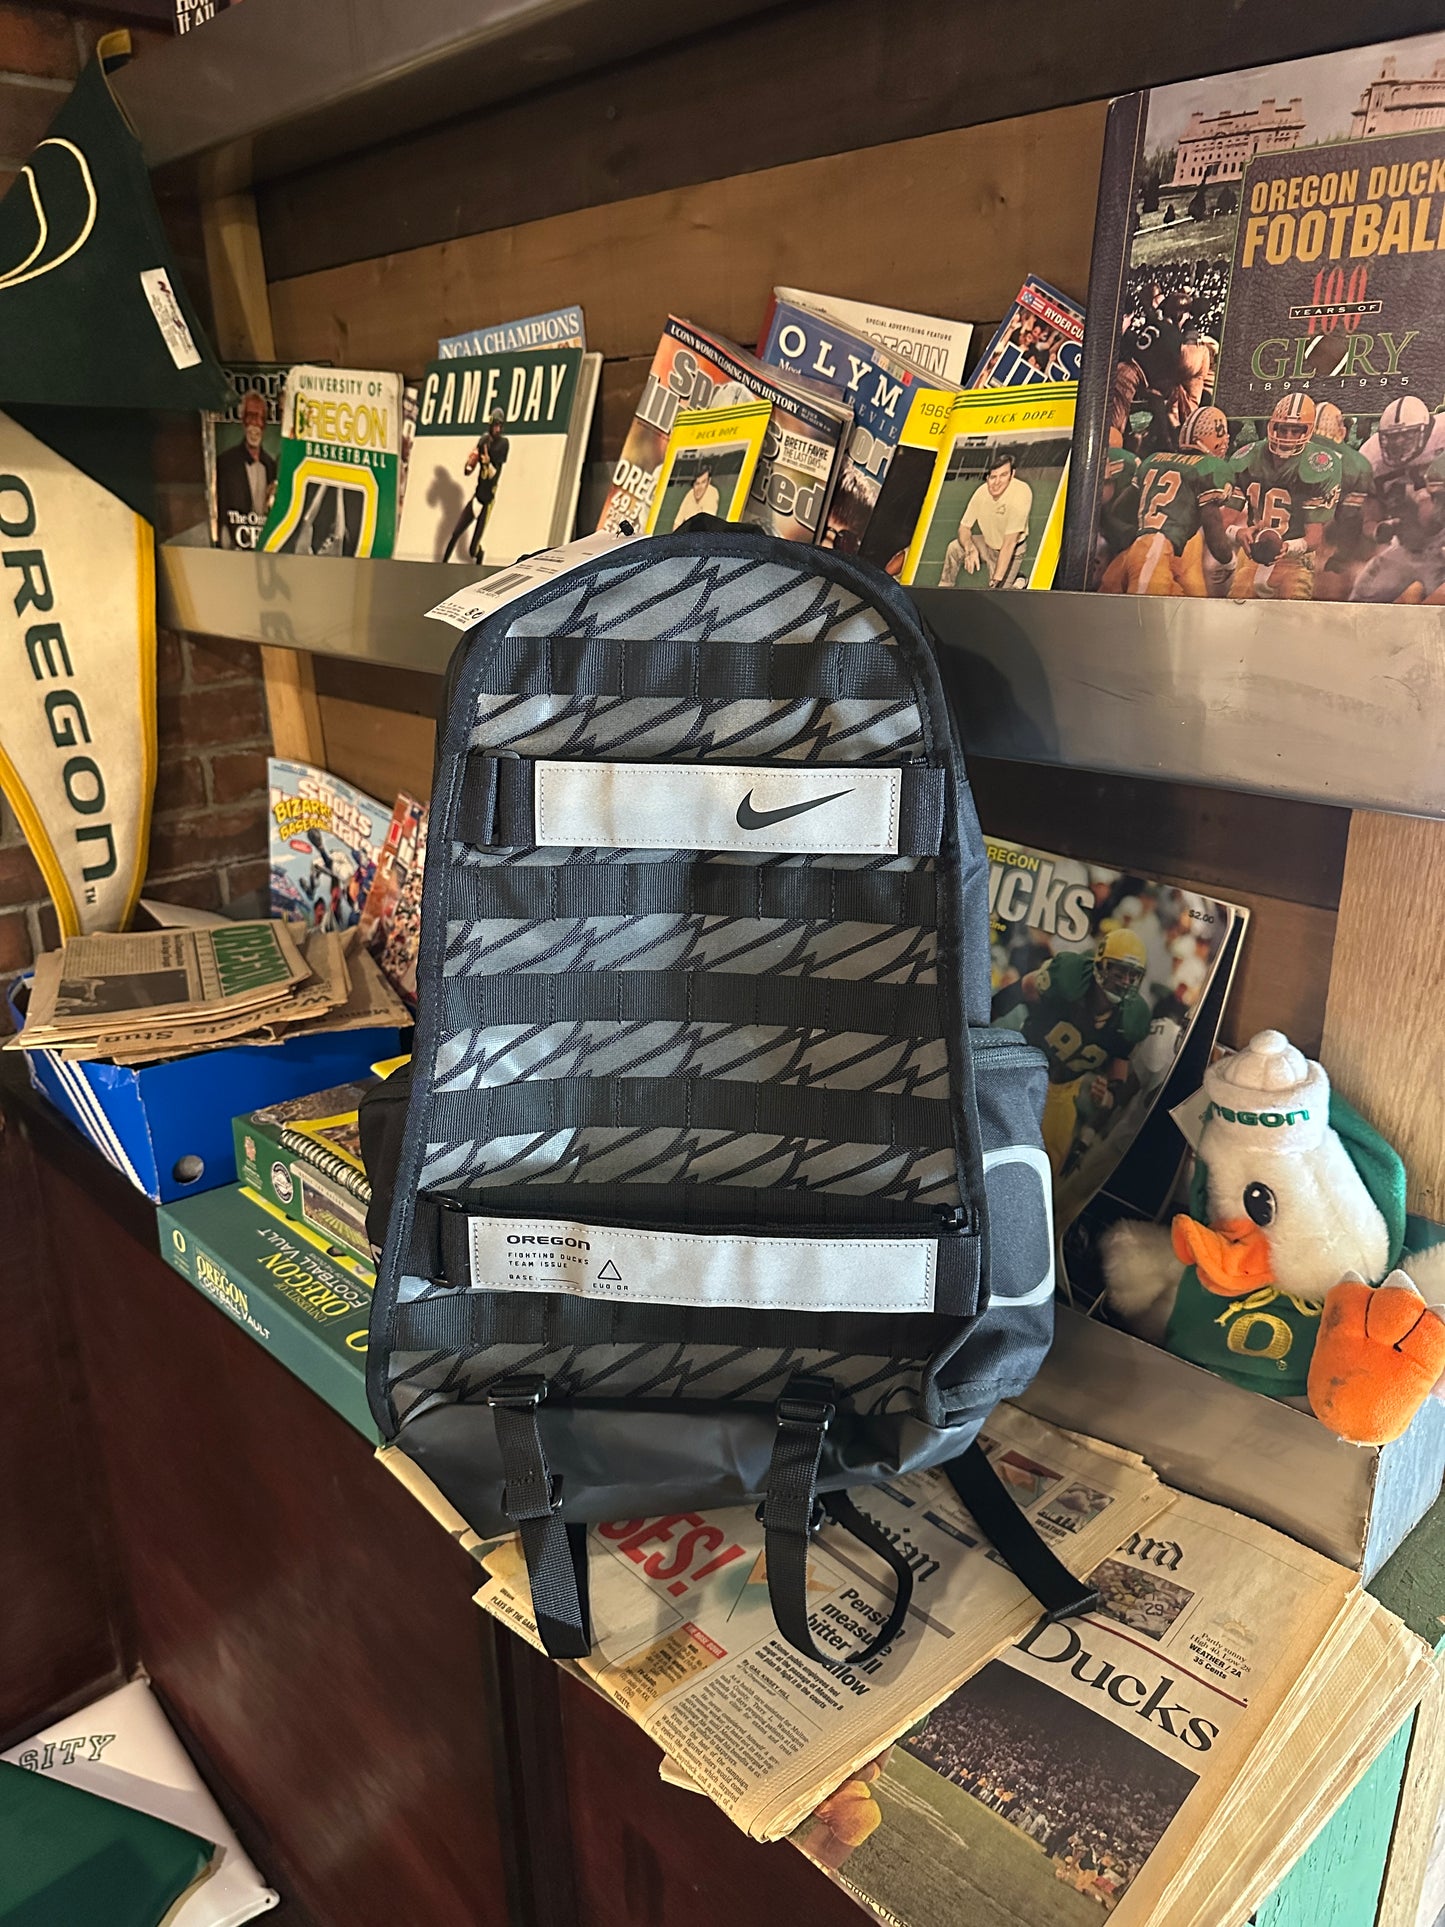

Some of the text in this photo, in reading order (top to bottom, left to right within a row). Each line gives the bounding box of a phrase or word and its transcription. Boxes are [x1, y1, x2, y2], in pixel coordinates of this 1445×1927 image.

[1250, 170, 1358, 214] OREGON
[1294, 303, 1378, 317] YEARS OF
[1308, 264, 1368, 335] 100
[440, 312, 580, 359] NCAA CHAMPIONS
[866, 317, 952, 342] SPECIAL ADVERTISING FEATURE
[1044, 307, 1071, 332] RYDER
[300, 375, 382, 396] UNIVERSITY OF
[670, 324, 800, 414] UCONN WOMEN CLOSING IN ON HISTORY
[421, 368, 500, 426] GAME
[506, 364, 567, 423] DAY
[294, 392, 388, 450] OREGON
[696, 426, 739, 441] DUCK DOPE
[984, 410, 1056, 424] DUCK DOPE
[306, 442, 386, 468] BASKETBALL
[784, 435, 829, 462] BRETT FAVRE
[793, 450, 807, 464] LAST
[806, 454, 822, 469] DAYS
[1138, 468, 1182, 530] 12
[1246, 482, 1292, 540] 16
[0, 474, 118, 883] OREGON
[1188, 908, 1215, 924] $2.00
[212, 924, 290, 997] OREGON
[193, 994, 332, 1038] Webfoots
[103, 1029, 174, 1044] Stun
[506, 1234, 590, 1250] OREGON
[560, 1254, 590, 1265] DUCKS
[196, 1254, 248, 1312] OREGON
[256, 1227, 370, 1309] FOOTBALL VAULT
[508, 1260, 568, 1269] TEAM ISSUE
[258, 1251, 350, 1319] OREGON
[274, 1282, 328, 1324] UNIVERSITY OF
[243, 1308, 271, 1340] VAULT
[1034, 1518, 1068, 1538] WEATHER
[490, 1594, 507, 1610] PLAYS
[504, 1604, 513, 1615] OF
[512, 1609, 523, 1623] THE
[521, 1616, 536, 1633] GAME
[808, 1613, 852, 1651] bitter
[821, 1603, 892, 1656] measue
[839, 1588, 906, 1640] Pensin
[693, 1631, 710, 1644] ROSE
[705, 1641, 723, 1656] BOWL
[1189, 1642, 1226, 1668] WEATHER
[1230, 1668, 1242, 1678] 2A
[1190, 1634, 1208, 1650] High
[1222, 1653, 1240, 1666] Low
[1240, 1664, 1252, 1673] 28
[1202, 1632, 1248, 1662] Partly sunny
[748, 1663, 761, 1675] GAIL
[760, 1673, 779, 1690] KINSEY
[777, 1687, 790, 1699] HILL
[761, 1644, 777, 1658] anger
[788, 1665, 811, 1685] passage
[814, 1686, 839, 1708] Measure
[762, 1656, 776, 1668] plan
[808, 1692, 827, 1709] courts
[774, 1643, 790, 1657] Some
[786, 1653, 804, 1669] public
[801, 1664, 829, 1690] employees
[1012, 1618, 1220, 1752] Ducks
[1193, 1656, 1228, 1680] 35 Cents
[775, 1722, 805, 1749] Washington
